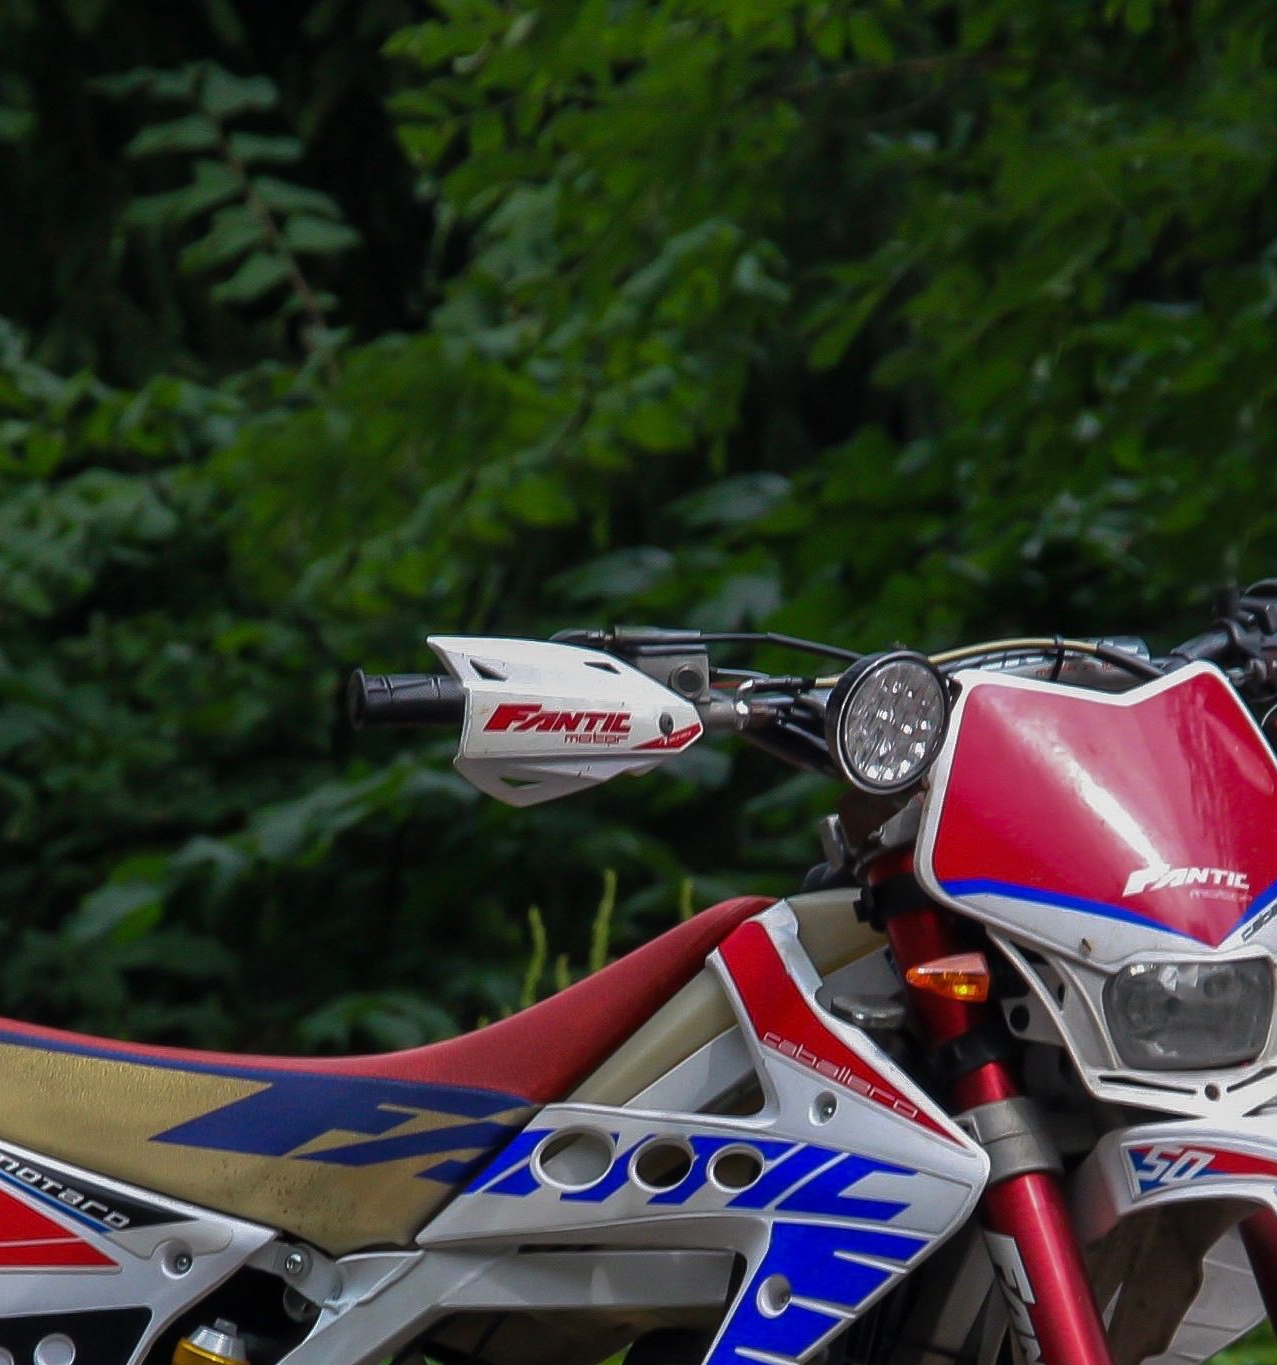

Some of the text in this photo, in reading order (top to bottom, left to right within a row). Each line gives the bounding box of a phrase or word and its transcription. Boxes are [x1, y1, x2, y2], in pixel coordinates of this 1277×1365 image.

[482, 703, 634, 733] FANTIC
[1122, 867, 1251, 898] FANTIC
[763, 1031, 918, 1119] caballero
[1136, 1144, 1217, 1183] 50
